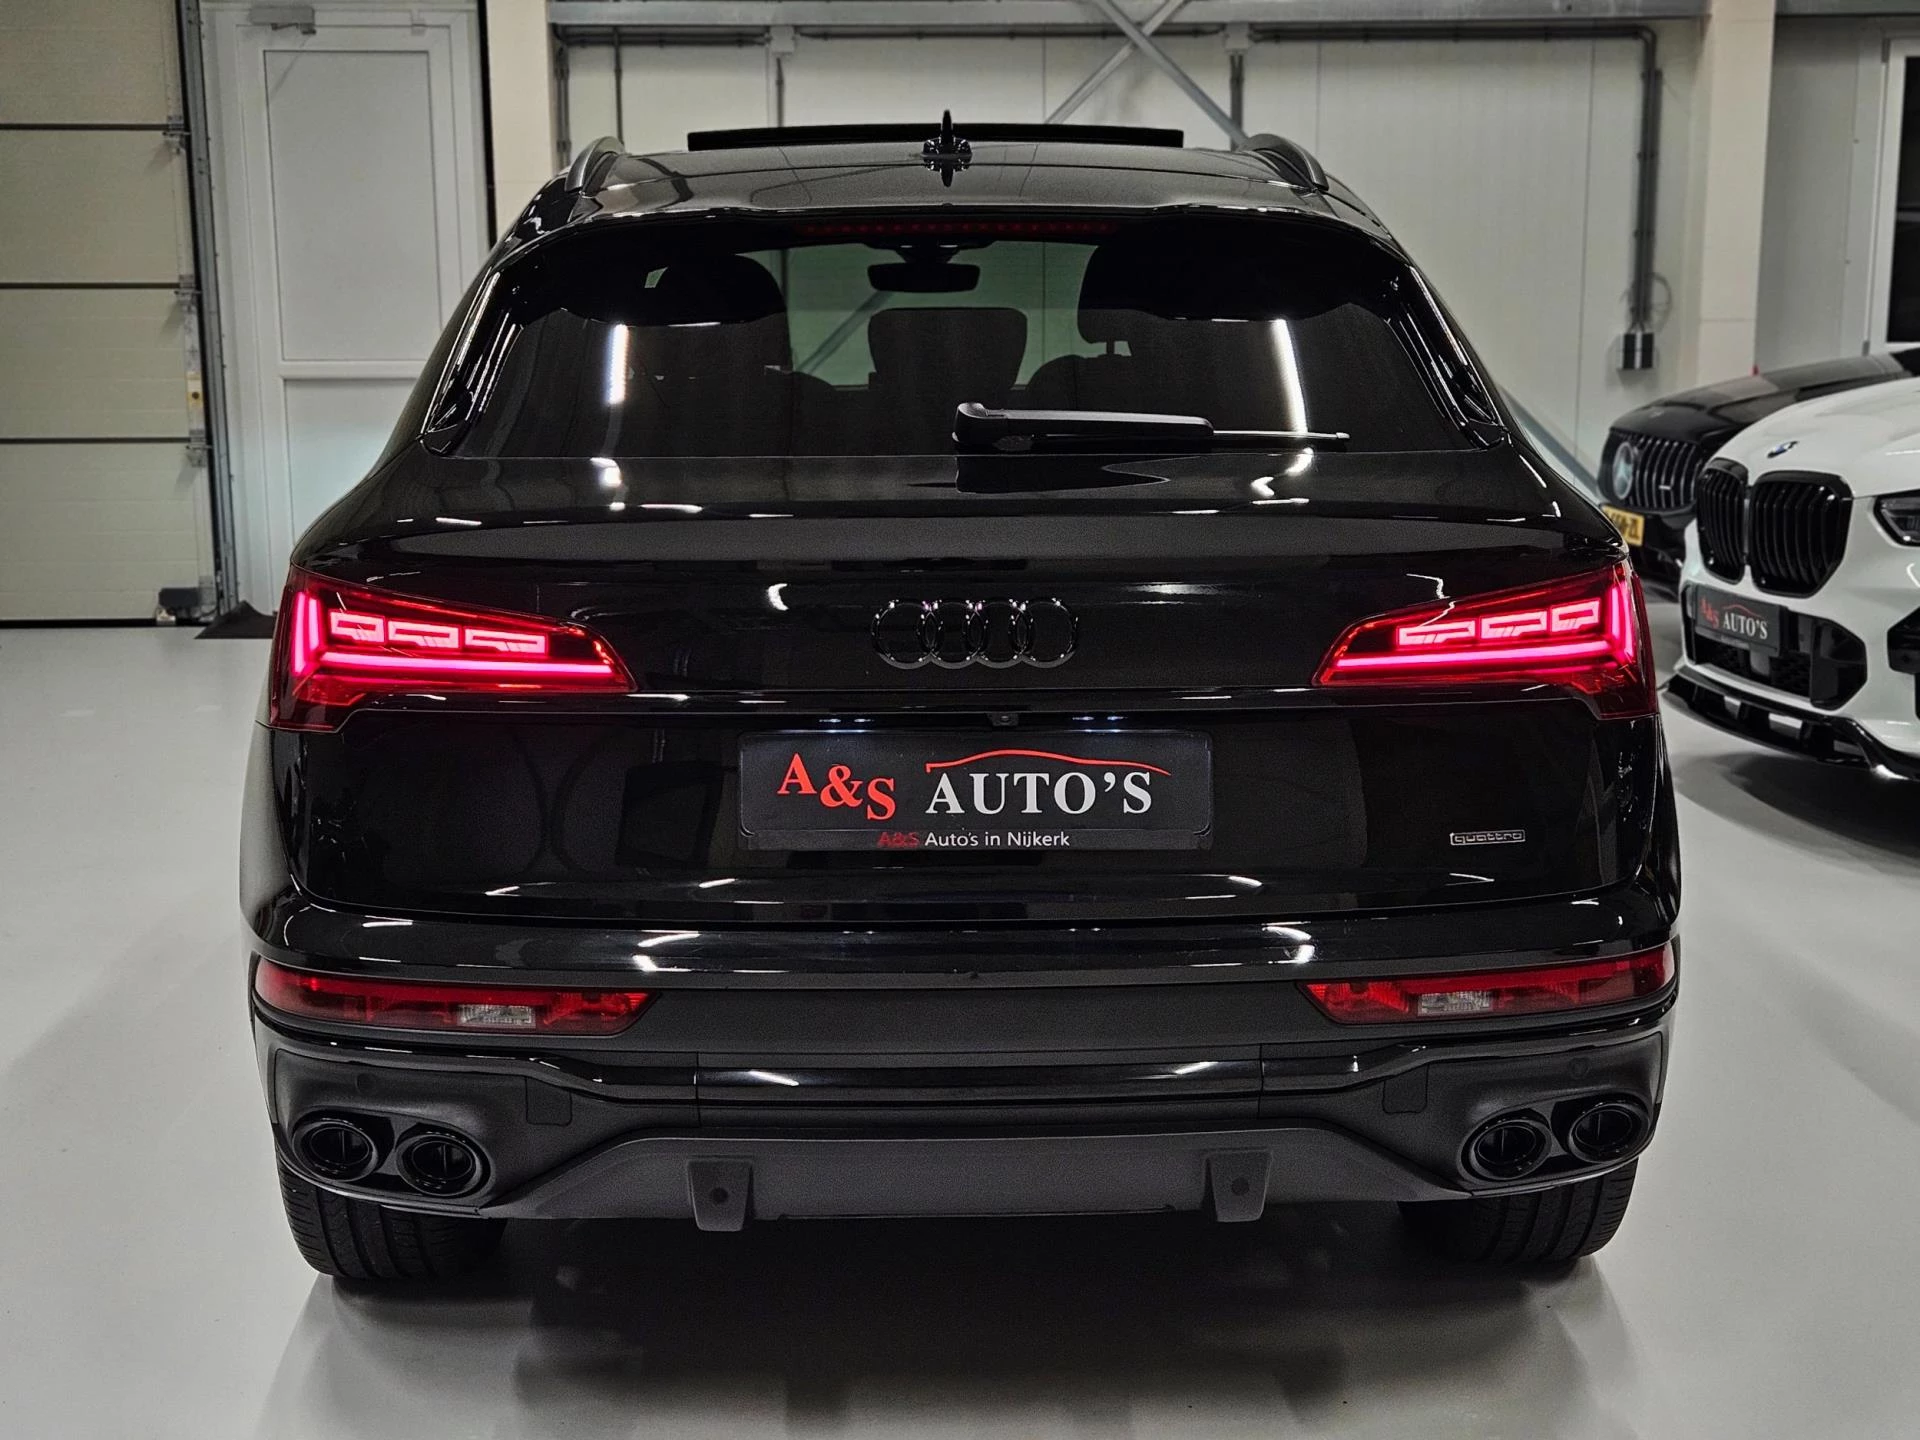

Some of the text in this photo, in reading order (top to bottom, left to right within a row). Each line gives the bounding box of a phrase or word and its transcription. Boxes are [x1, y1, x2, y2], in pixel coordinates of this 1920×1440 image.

[1723, 612, 1768, 640] AUTO'S
[777, 753, 1152, 820] A&S AUTO'S
[878, 831, 1070, 848] A&S Auto's in Nijkerk
[1454, 832, 1523, 845] quattro
